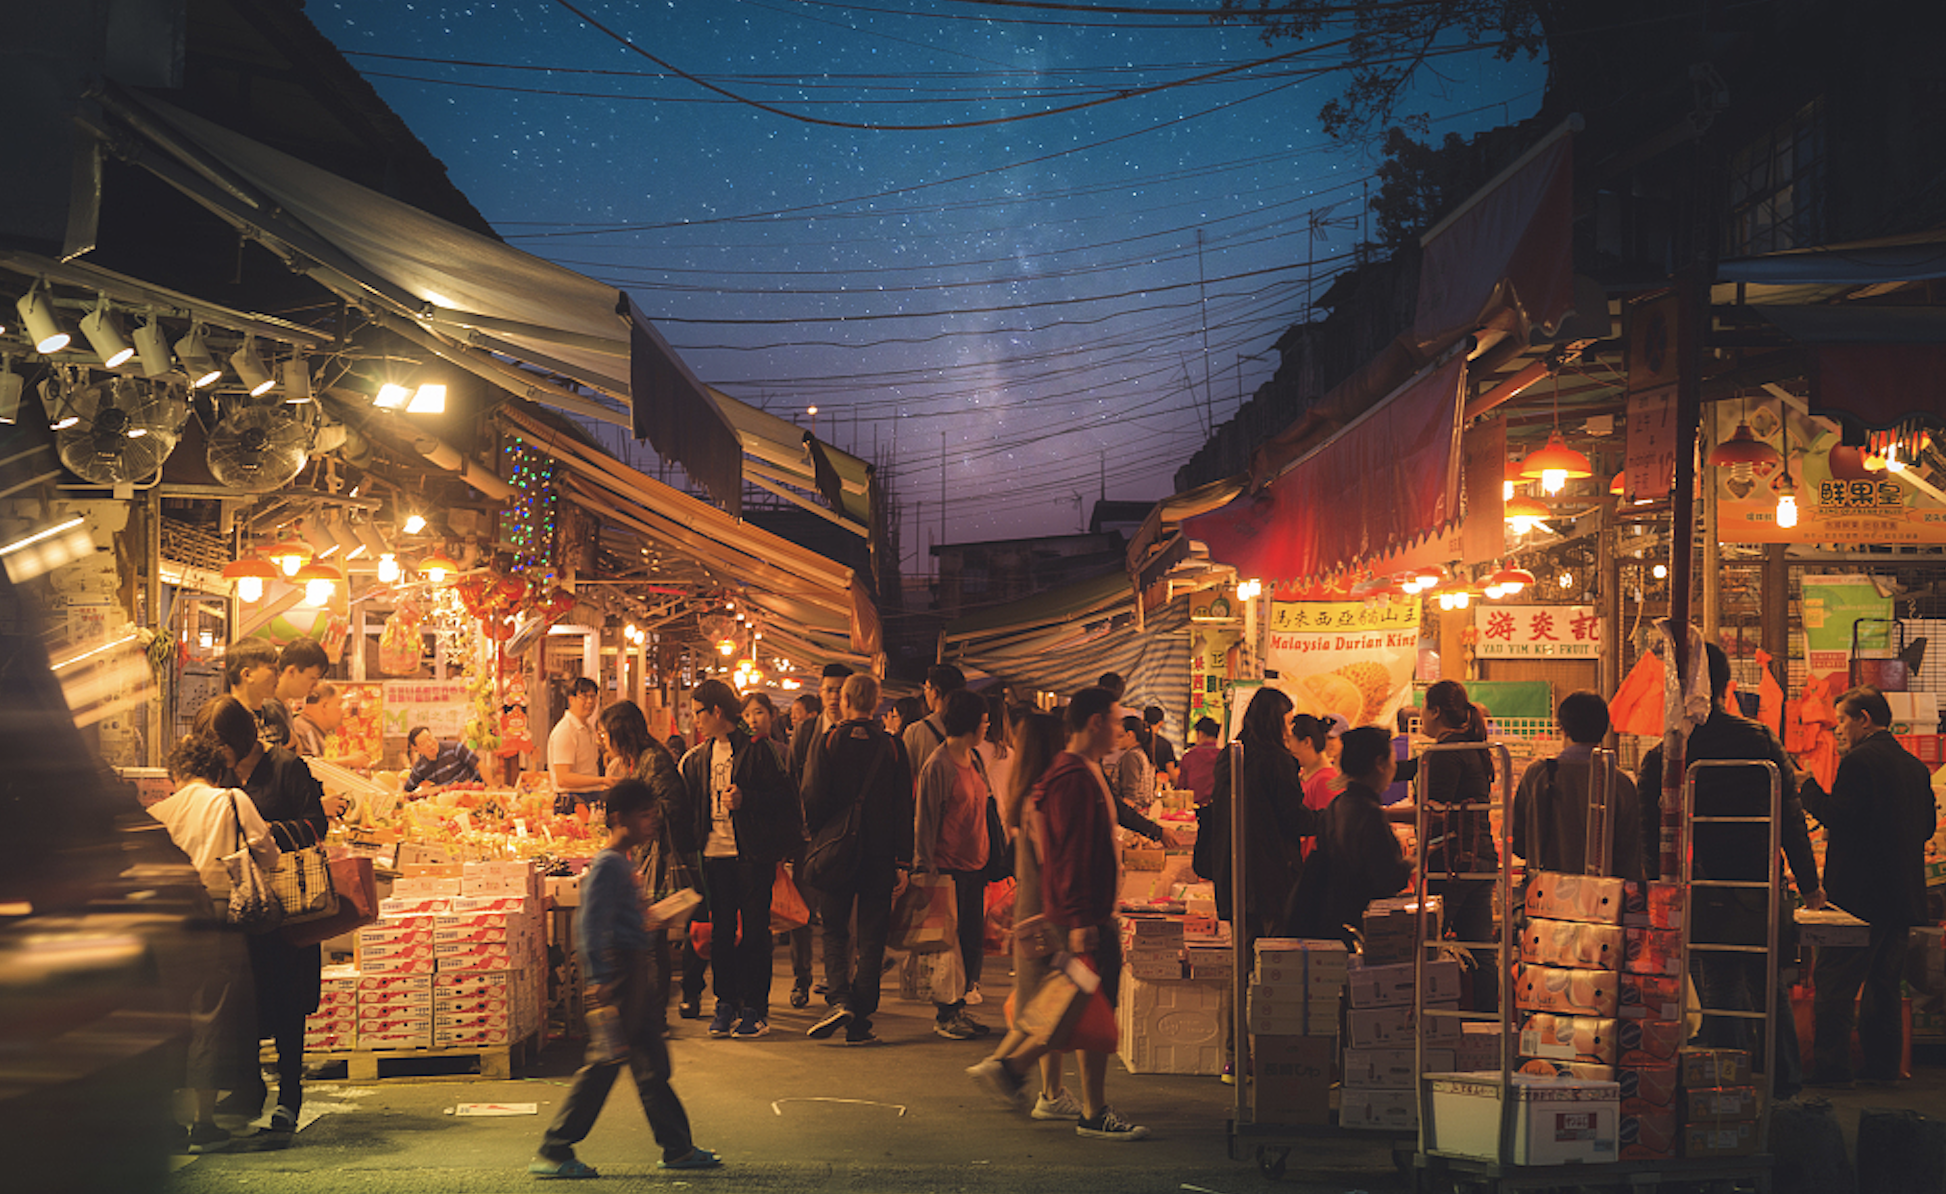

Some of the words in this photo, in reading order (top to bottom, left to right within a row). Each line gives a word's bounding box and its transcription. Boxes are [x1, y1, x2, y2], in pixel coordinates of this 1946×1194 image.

[1821, 481, 1900, 505] 鮮果皇
[1485, 610, 1600, 641] 游炎記
[1270, 634, 1330, 653] Malaysia
[1335, 635, 1382, 651] Durian
[1386, 633, 1417, 648] King
[1559, 644, 1589, 655] FRUIT
